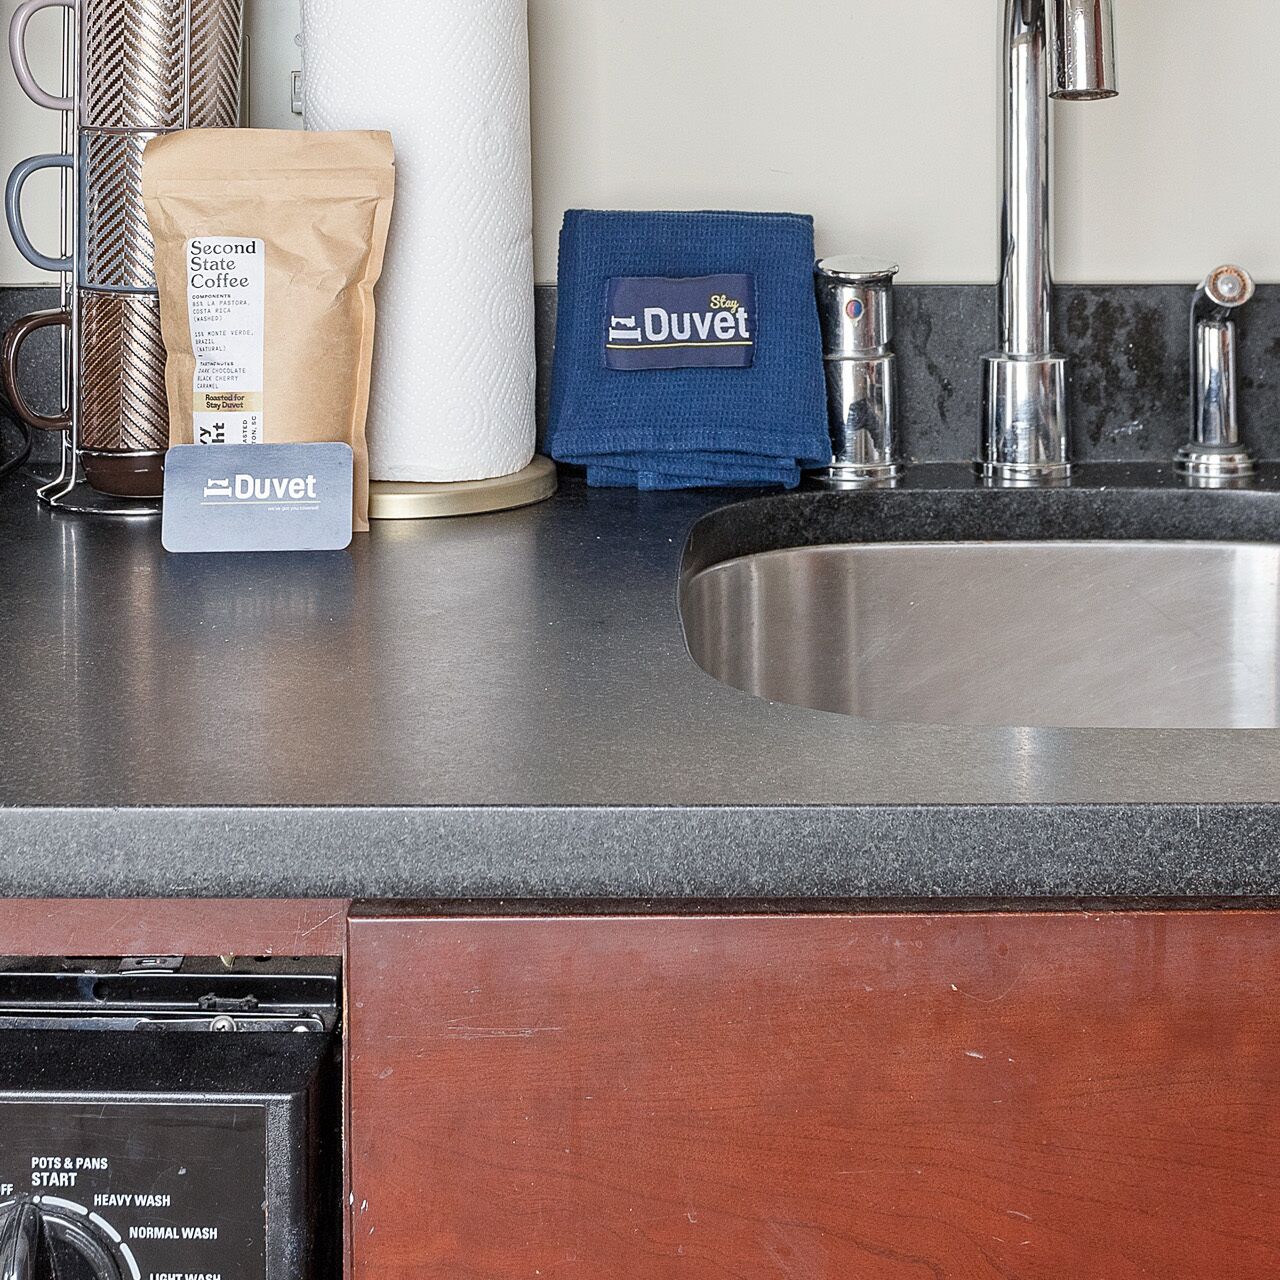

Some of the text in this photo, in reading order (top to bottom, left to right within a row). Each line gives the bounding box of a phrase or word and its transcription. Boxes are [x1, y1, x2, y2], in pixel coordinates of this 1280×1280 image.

[190, 240, 256, 255] Second
[190, 256, 236, 271] State
[191, 272, 249, 289] Coffee
[710, 294, 739, 314] Stay
[644, 307, 750, 342] Duvet
[233, 393, 245, 401] for
[206, 401, 221, 411] Stay
[234, 474, 316, 499] Duvet
[31, 1157, 108, 1170] POTS & PANS
[31, 1172, 78, 1187] START
[94, 1194, 171, 1207] HEAVY WASH
[129, 1227, 218, 1240] NORMAL WASH
